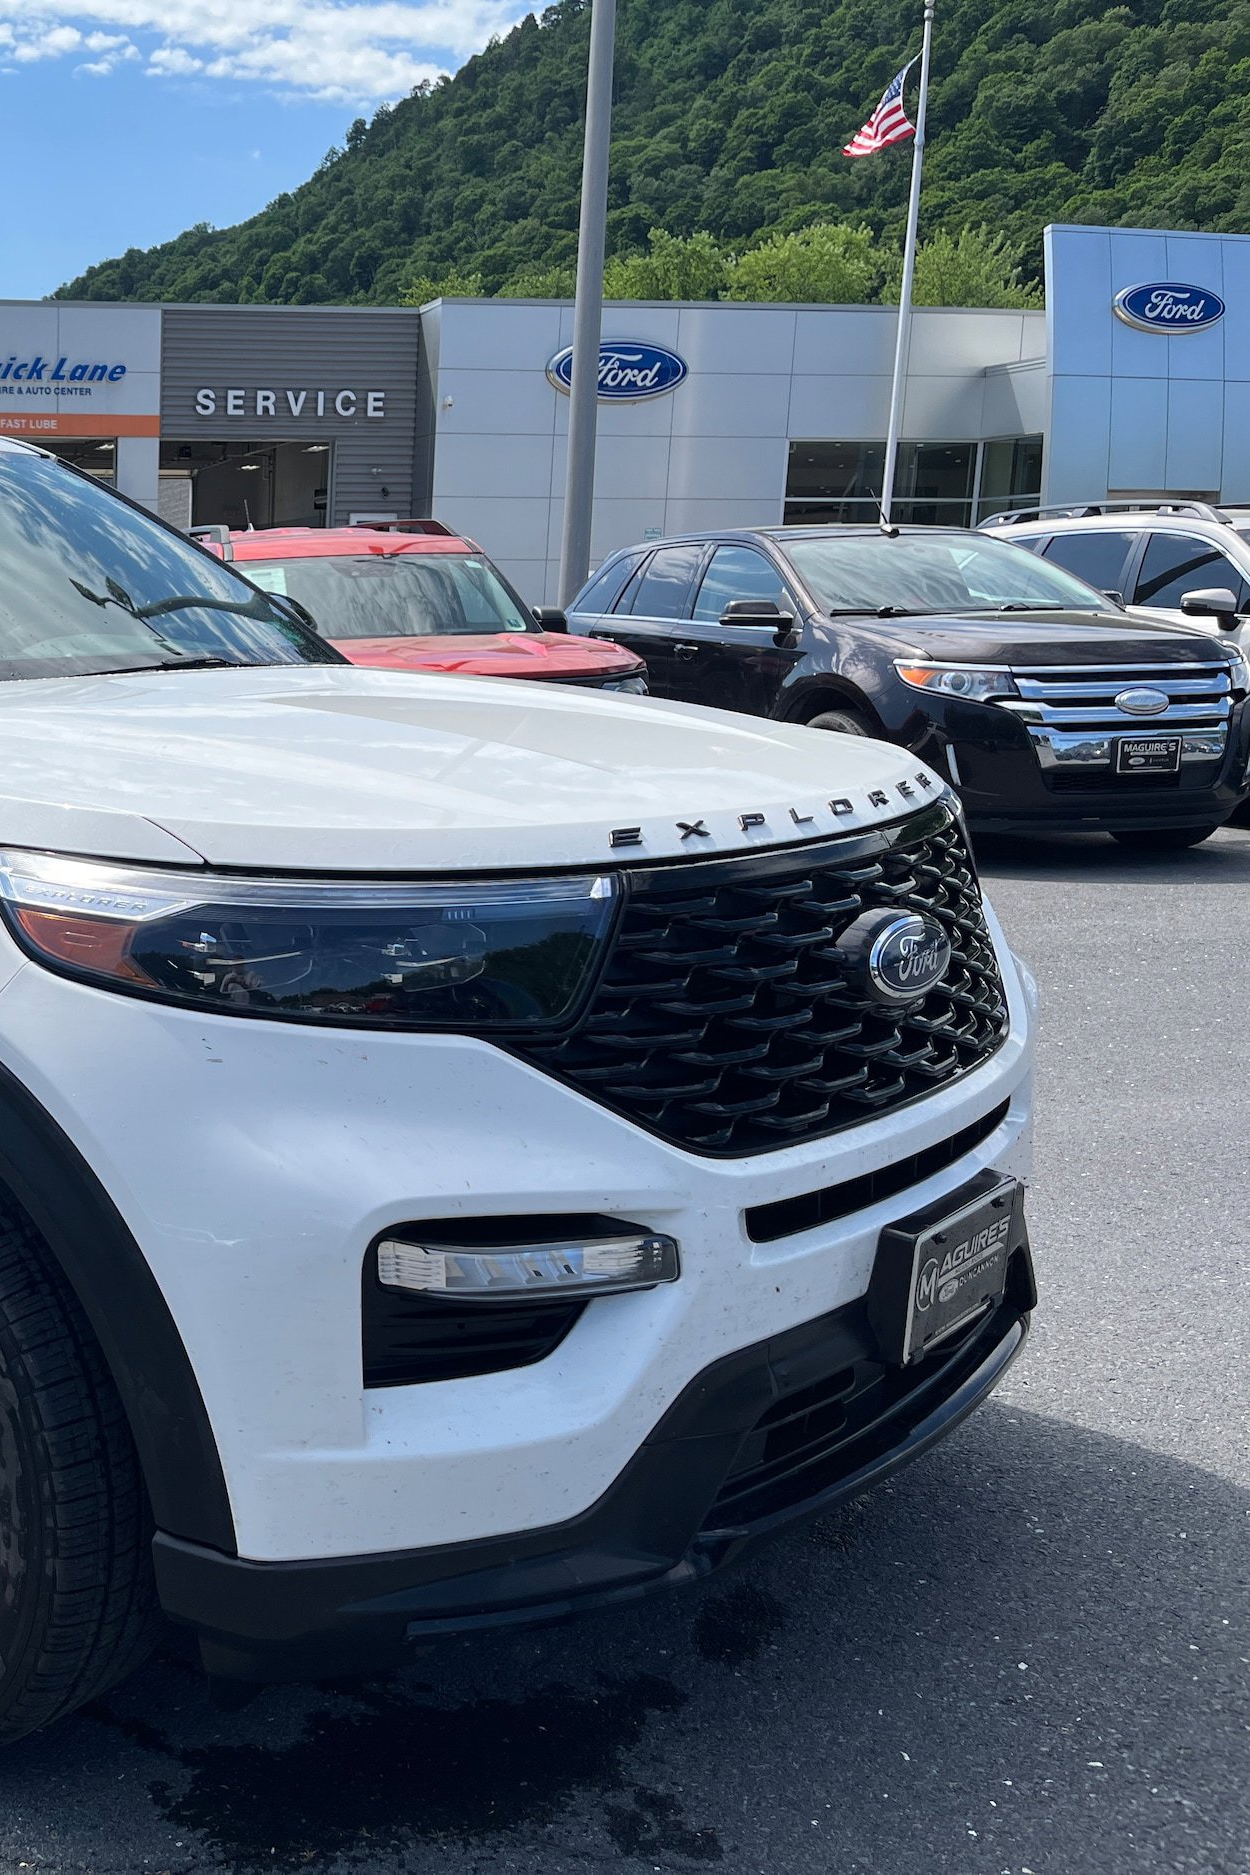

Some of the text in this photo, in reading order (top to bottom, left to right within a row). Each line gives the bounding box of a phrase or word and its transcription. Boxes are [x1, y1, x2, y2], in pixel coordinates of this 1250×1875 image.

[1144, 289, 1206, 321] Ford
[50, 357, 127, 382] Lane
[16, 386, 23, 395] &
[25, 387, 51, 395] AUTO
[53, 387, 92, 396] CENTER
[195, 388, 386, 417] SERVICE
[0, 418, 58, 430] FAST LUBE
[608, 772, 933, 849] EXPLORER
[22, 884, 149, 912] EXPLORER
[898, 931, 939, 981] Ford
